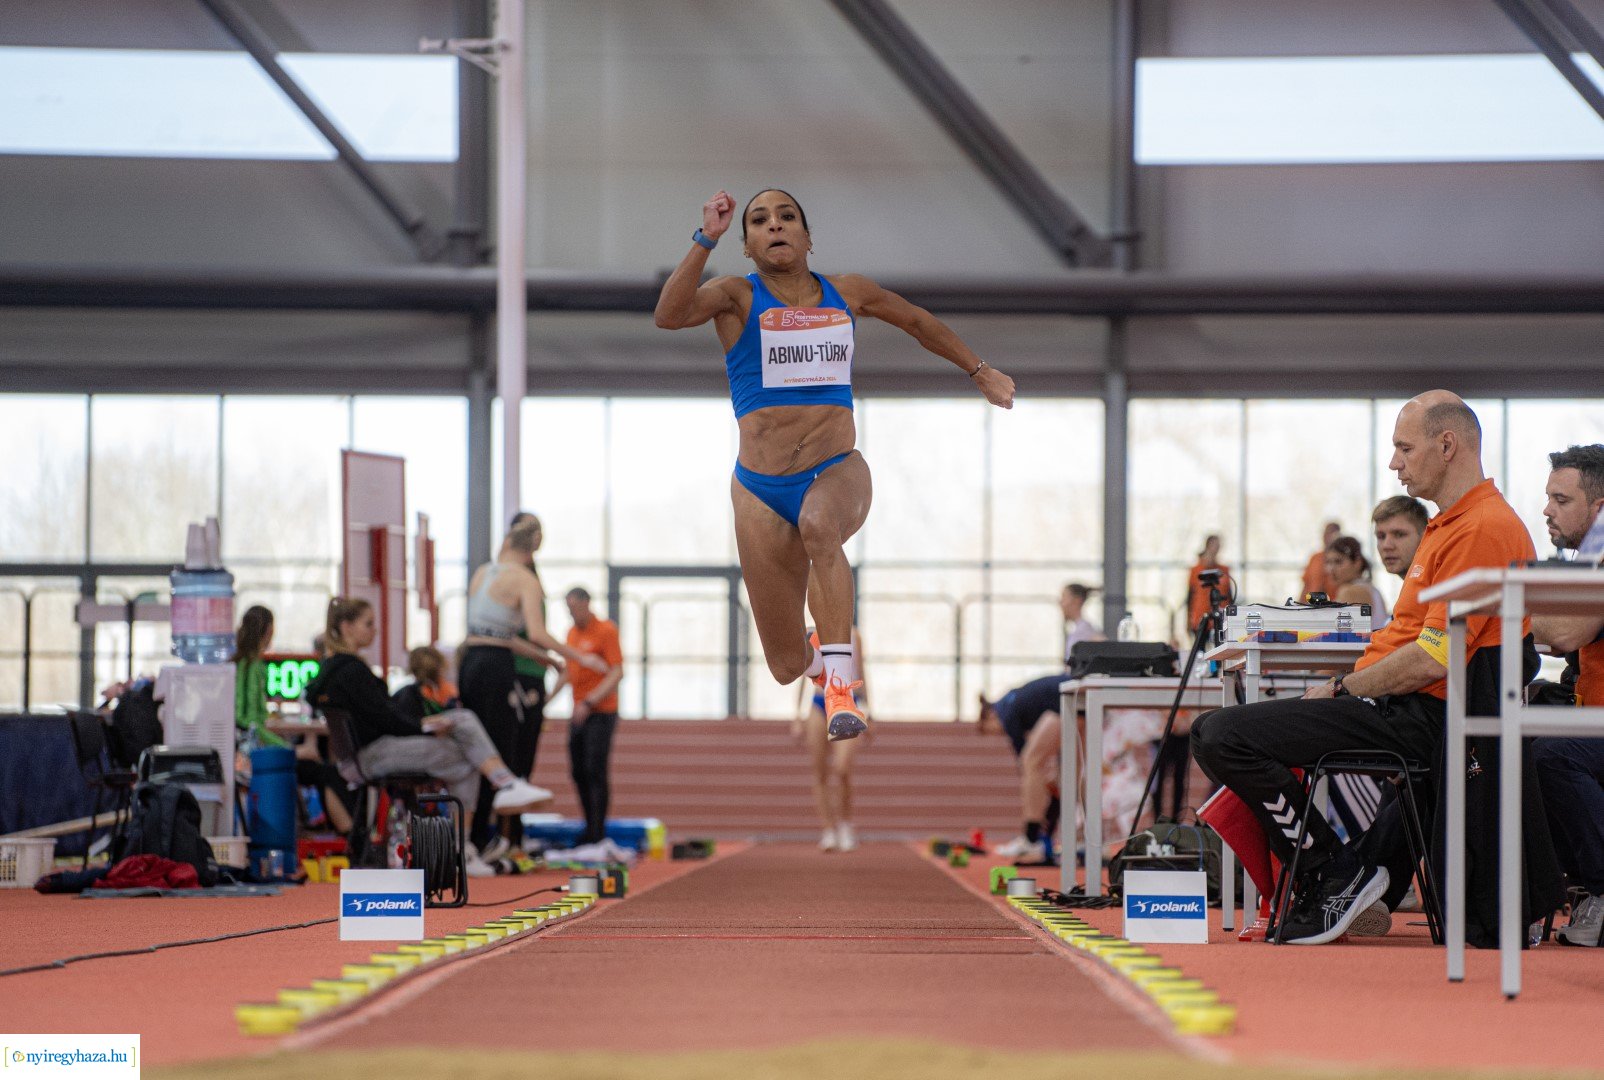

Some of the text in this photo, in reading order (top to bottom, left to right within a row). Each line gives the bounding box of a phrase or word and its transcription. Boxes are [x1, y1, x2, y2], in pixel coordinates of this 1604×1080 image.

[768, 341, 849, 365] ABIWU-TÜRK
[365, 899, 416, 912] polanik
[1150, 901, 1200, 914] polanik
